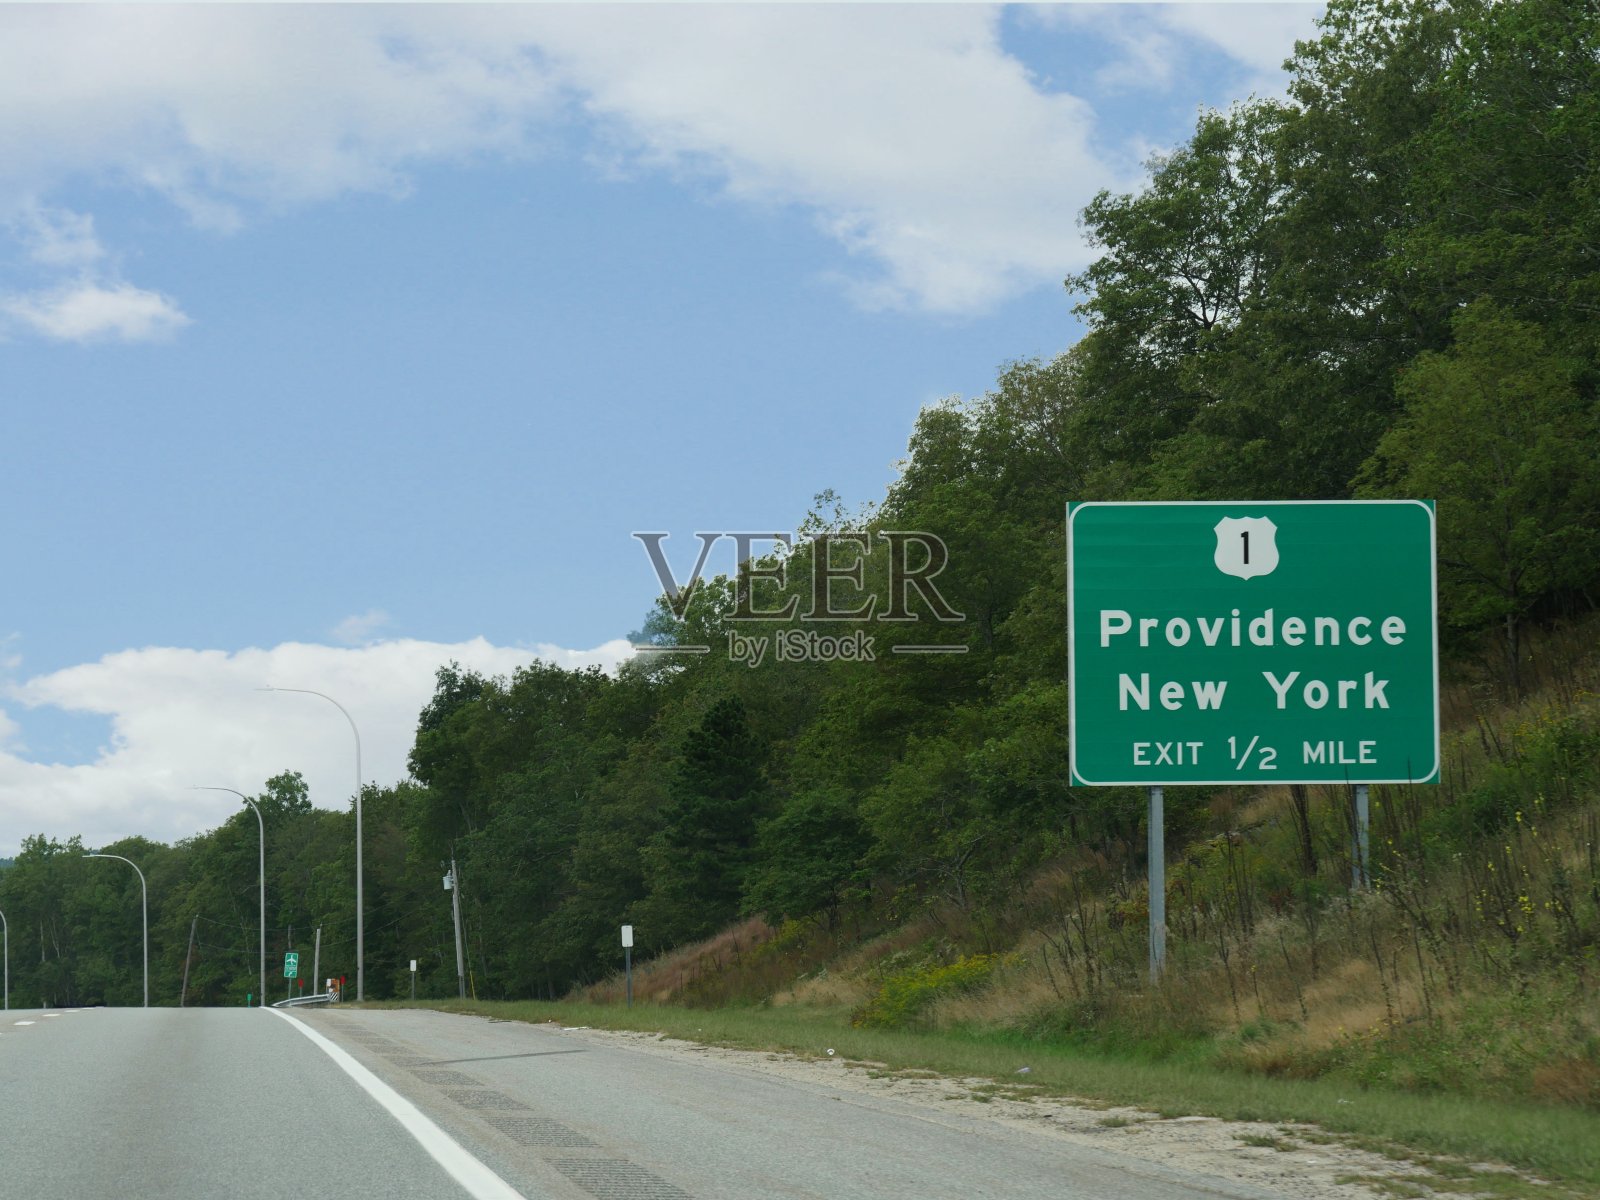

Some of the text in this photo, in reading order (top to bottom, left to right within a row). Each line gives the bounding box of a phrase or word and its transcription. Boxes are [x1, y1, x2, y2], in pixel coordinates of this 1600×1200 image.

[1240, 530, 1250, 565] 1
[1100, 607, 1407, 648] Providence
[1118, 670, 1390, 711] New York
[1132, 735, 1378, 770] EXIT 1/2 MILE
